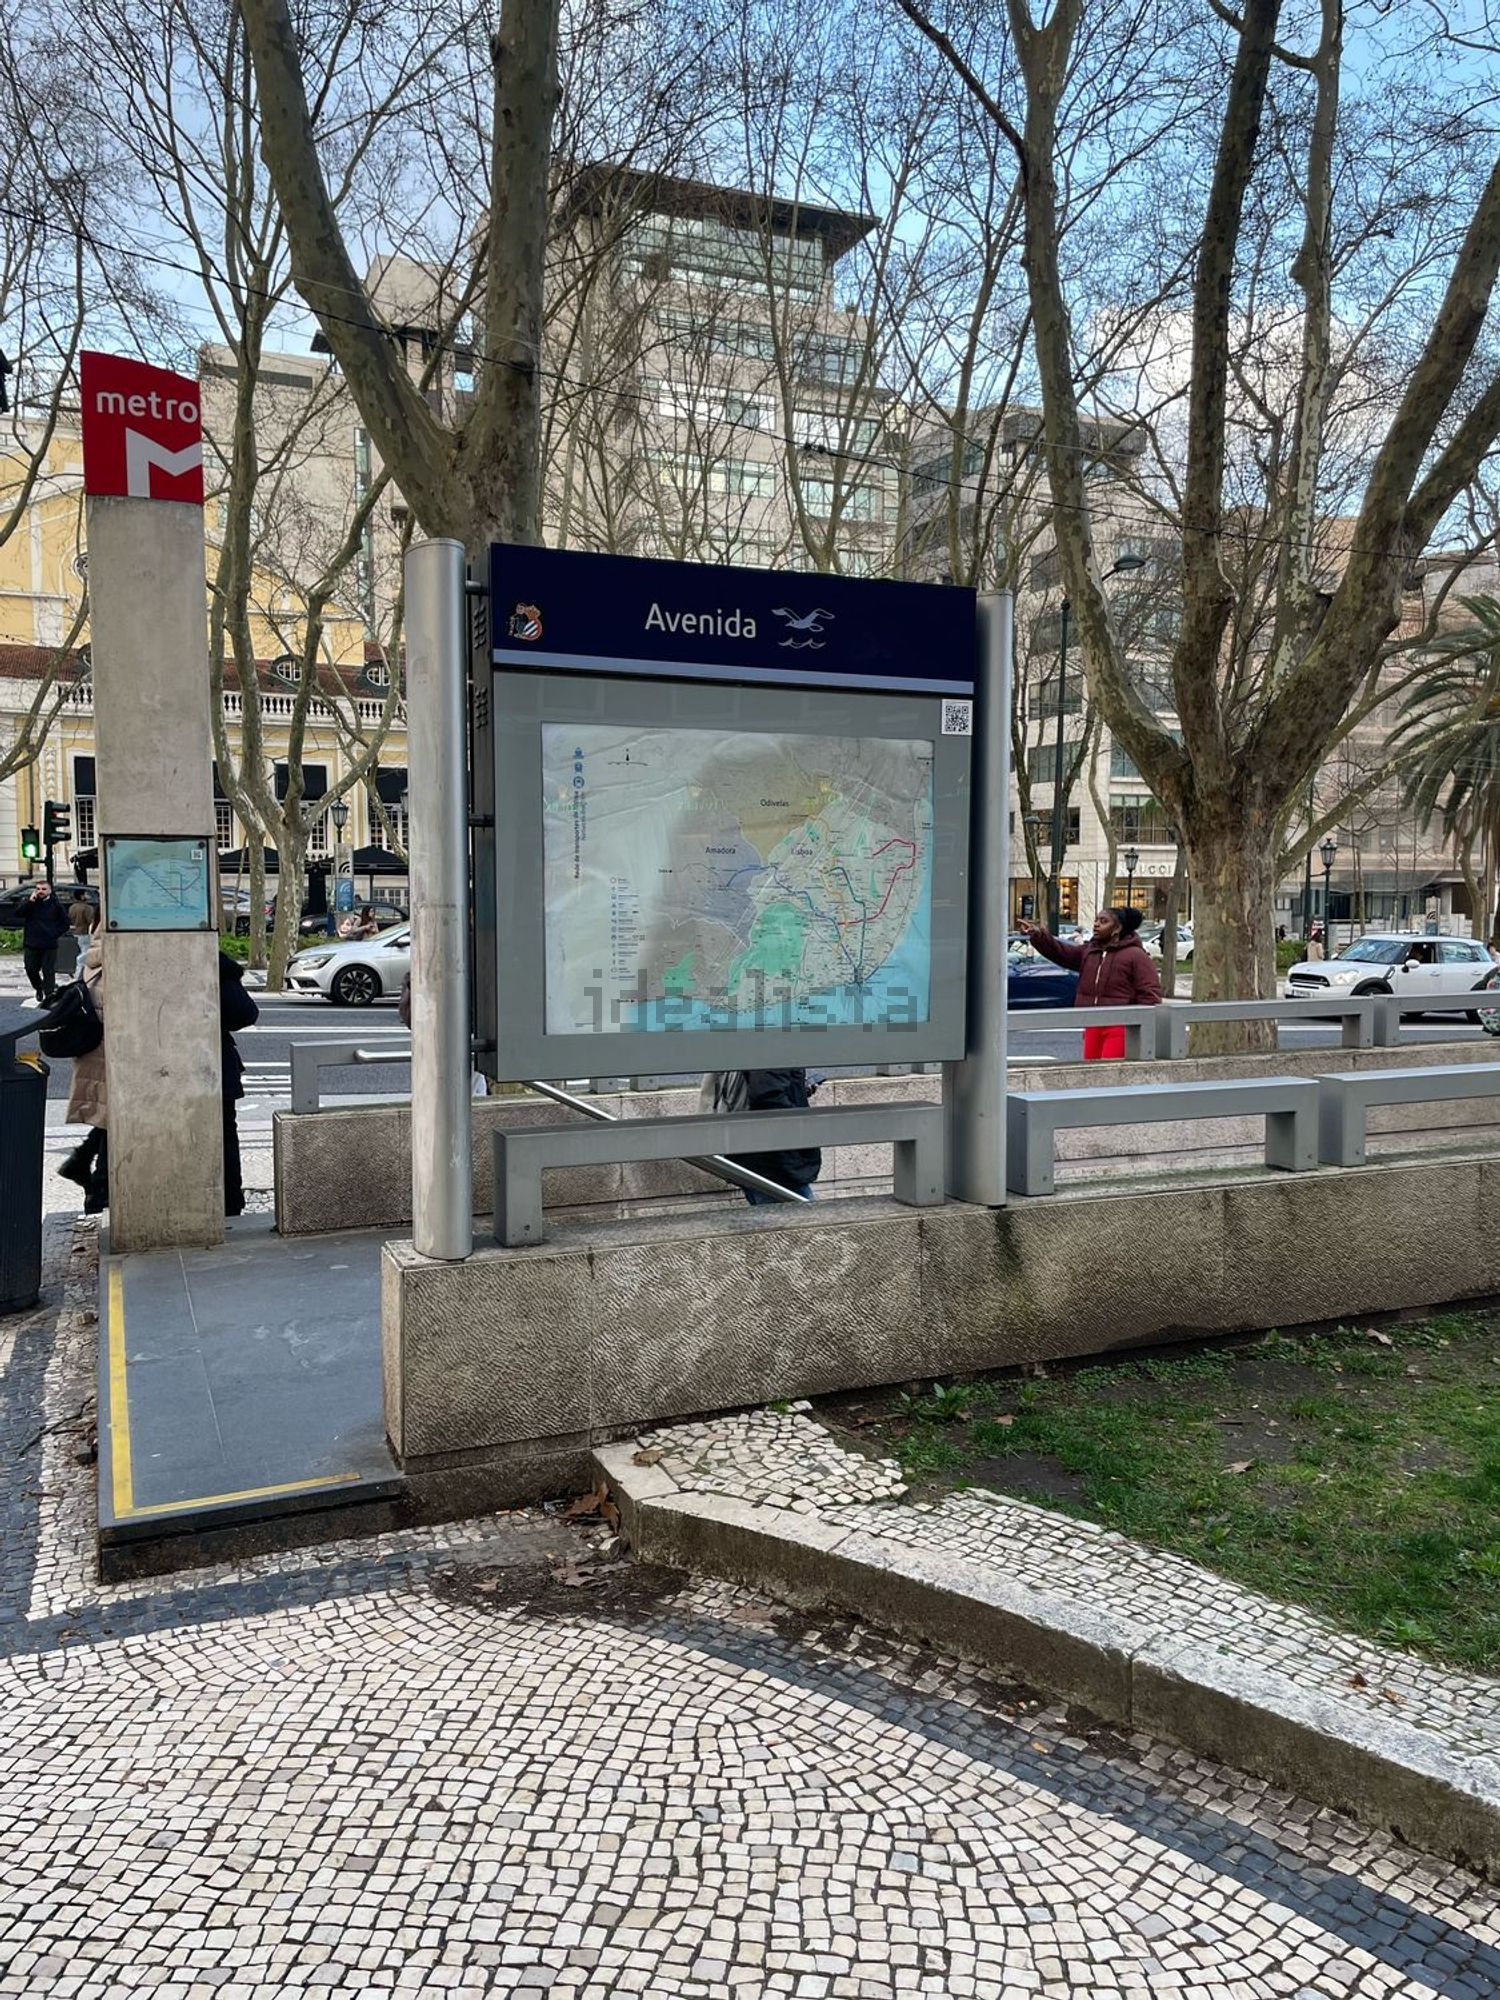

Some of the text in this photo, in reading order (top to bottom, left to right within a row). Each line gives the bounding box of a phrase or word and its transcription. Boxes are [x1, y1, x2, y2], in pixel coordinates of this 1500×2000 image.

[97, 391, 198, 423] metro
[645, 603, 756, 638] Avenida
[759, 799, 790, 807] Odivelas
[705, 846, 736, 855] Amadora
[1132, 865, 1171, 875] UCCI
